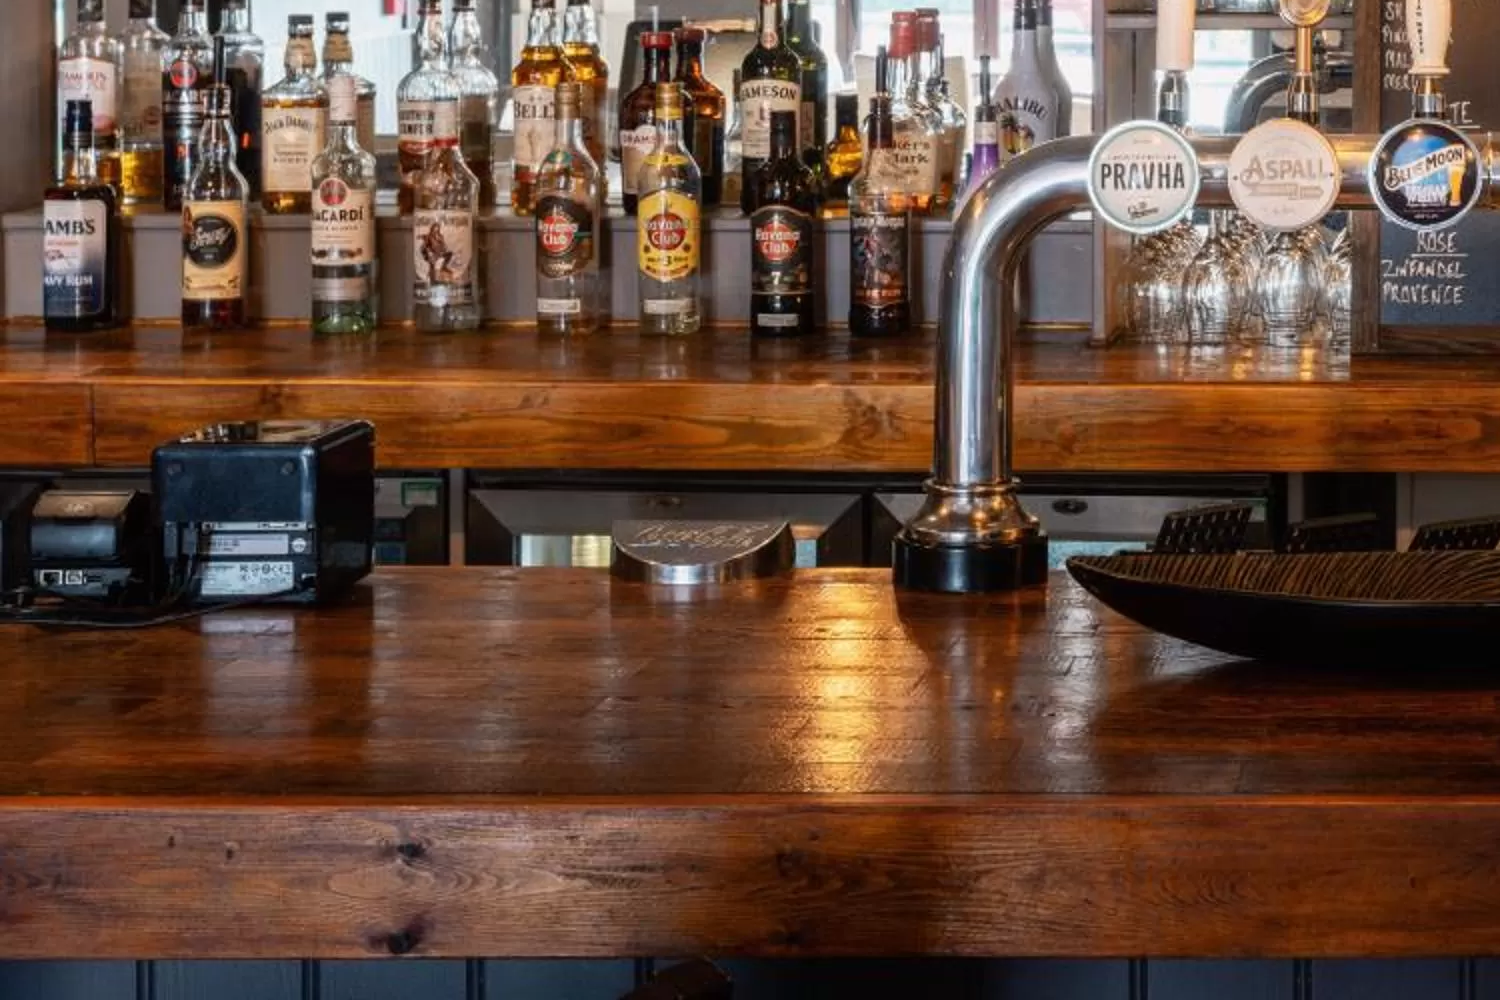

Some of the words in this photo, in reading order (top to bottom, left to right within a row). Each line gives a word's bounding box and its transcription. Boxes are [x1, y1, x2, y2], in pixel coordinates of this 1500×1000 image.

[1425, 147, 1463, 170] MOON
[1100, 162, 1185, 190] PRAVHA
[43, 217, 96, 236] AMB'S
[651, 231, 682, 245] Club
[1383, 281, 1465, 305] PROVENCE
